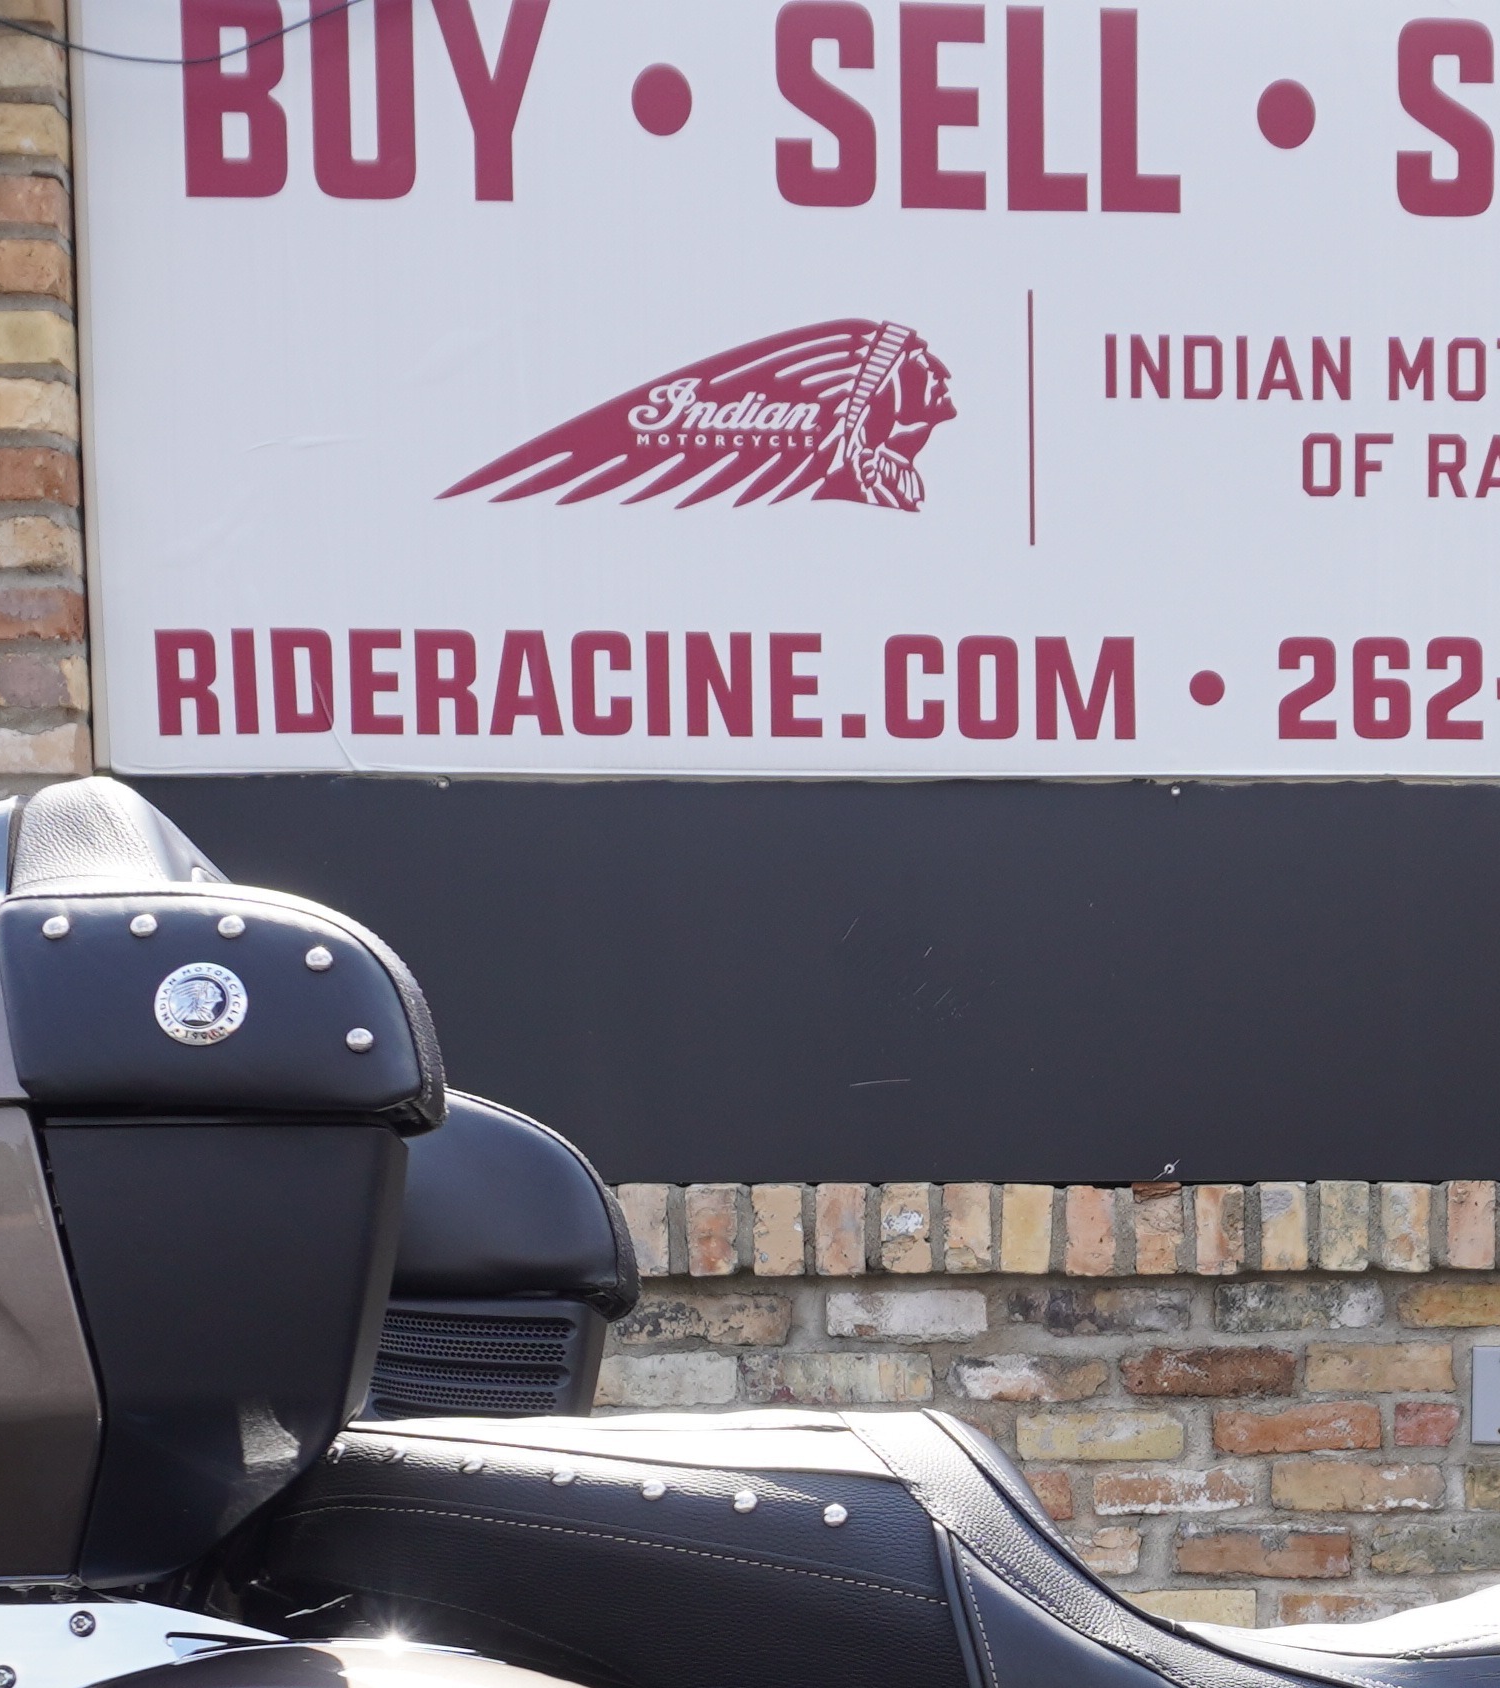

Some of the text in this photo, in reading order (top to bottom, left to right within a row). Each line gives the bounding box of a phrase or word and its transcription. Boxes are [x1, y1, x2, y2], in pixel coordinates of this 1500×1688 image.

[182, 0, 548, 201] BUY
[777, 2, 1179, 212] SELL
[1106, 335, 1349, 401] INDIAN
[628, 377, 821, 431] Indian
[636, 433, 814, 448] MOTORCYCLE
[1302, 434, 1393, 498] OF
[155, 629, 1136, 740] RIDERACINE.COM
[159, 966, 242, 1028] INDIAN MOTORCYCLE
